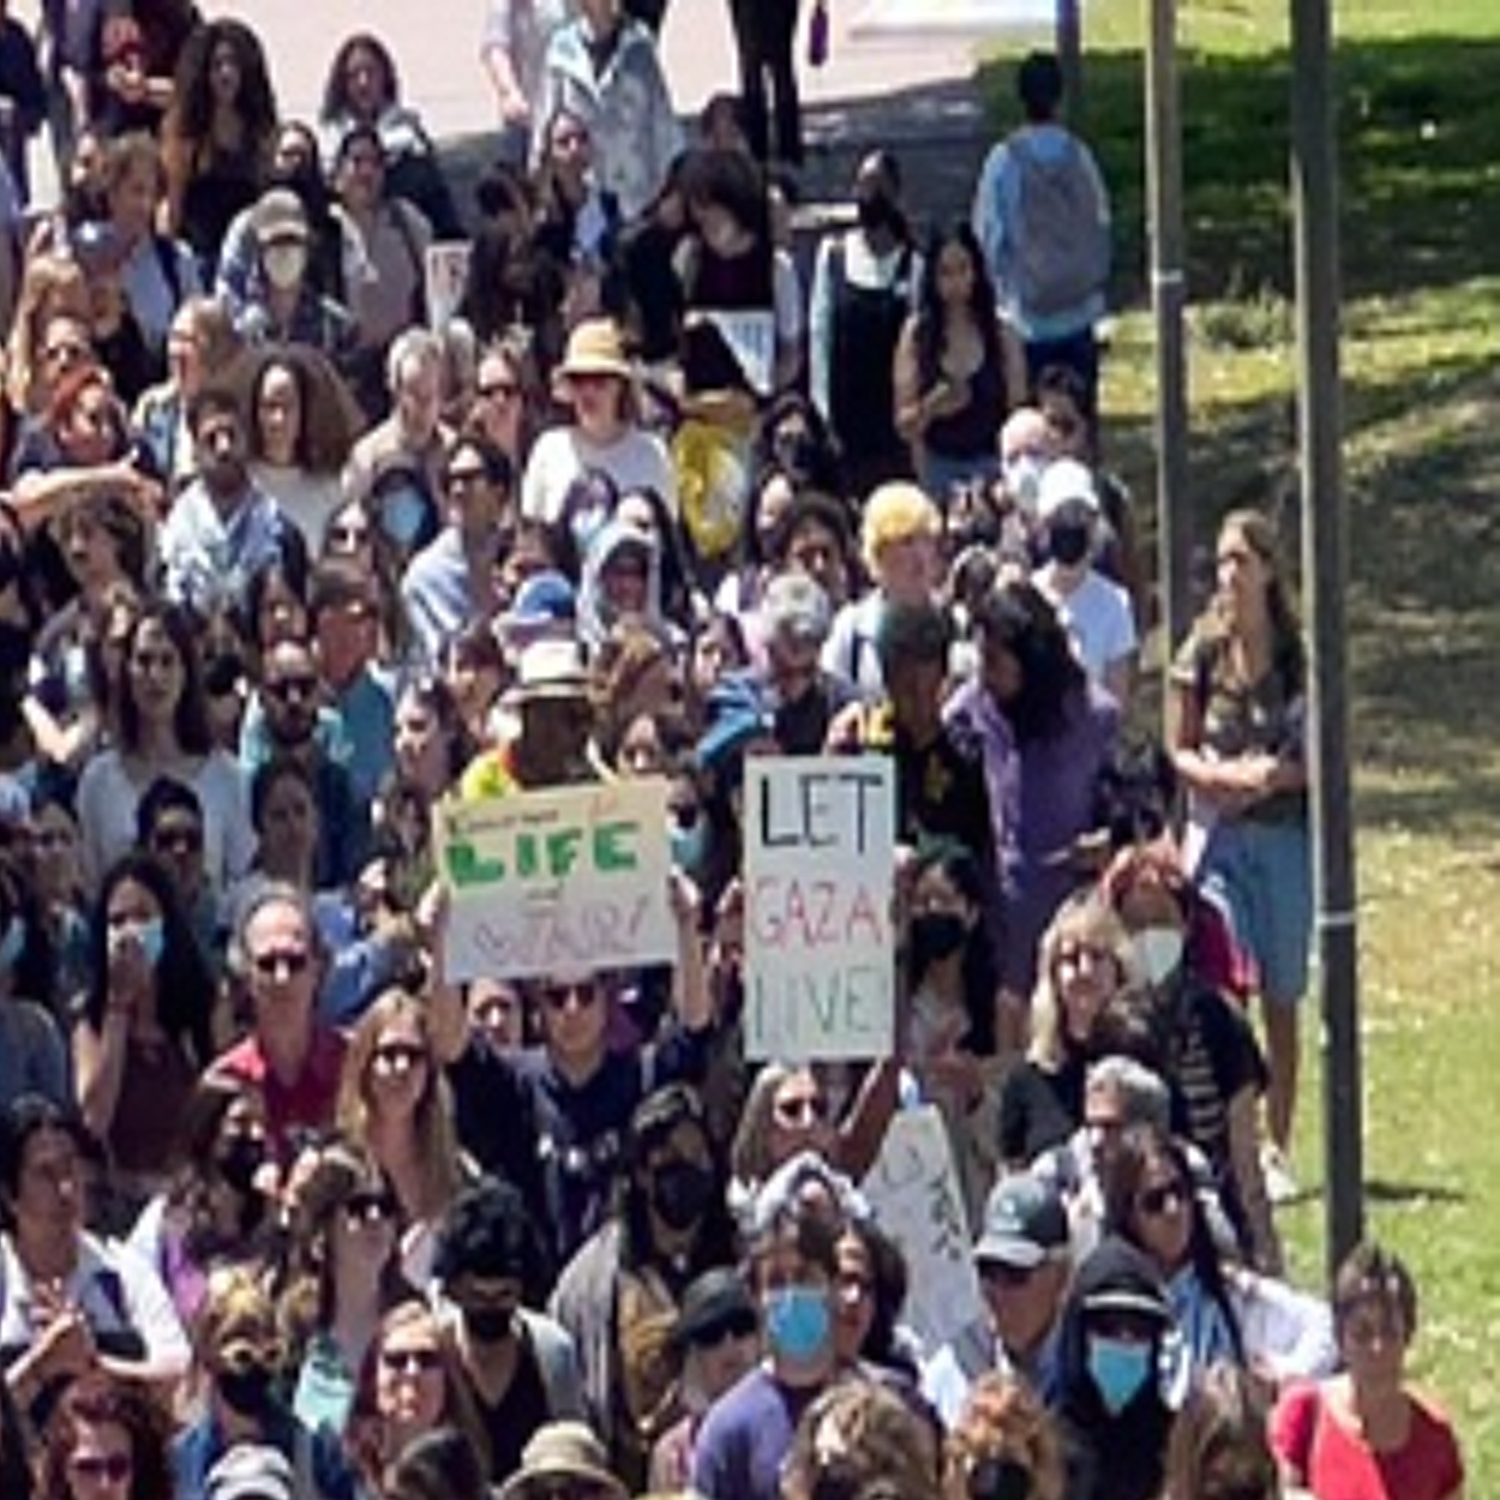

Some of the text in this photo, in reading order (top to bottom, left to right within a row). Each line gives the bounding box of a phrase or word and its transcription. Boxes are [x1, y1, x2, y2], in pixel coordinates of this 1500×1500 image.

[760, 772, 884, 853] LET
[445, 821, 638, 889] LIFE
[753, 876, 883, 949] GAZA
